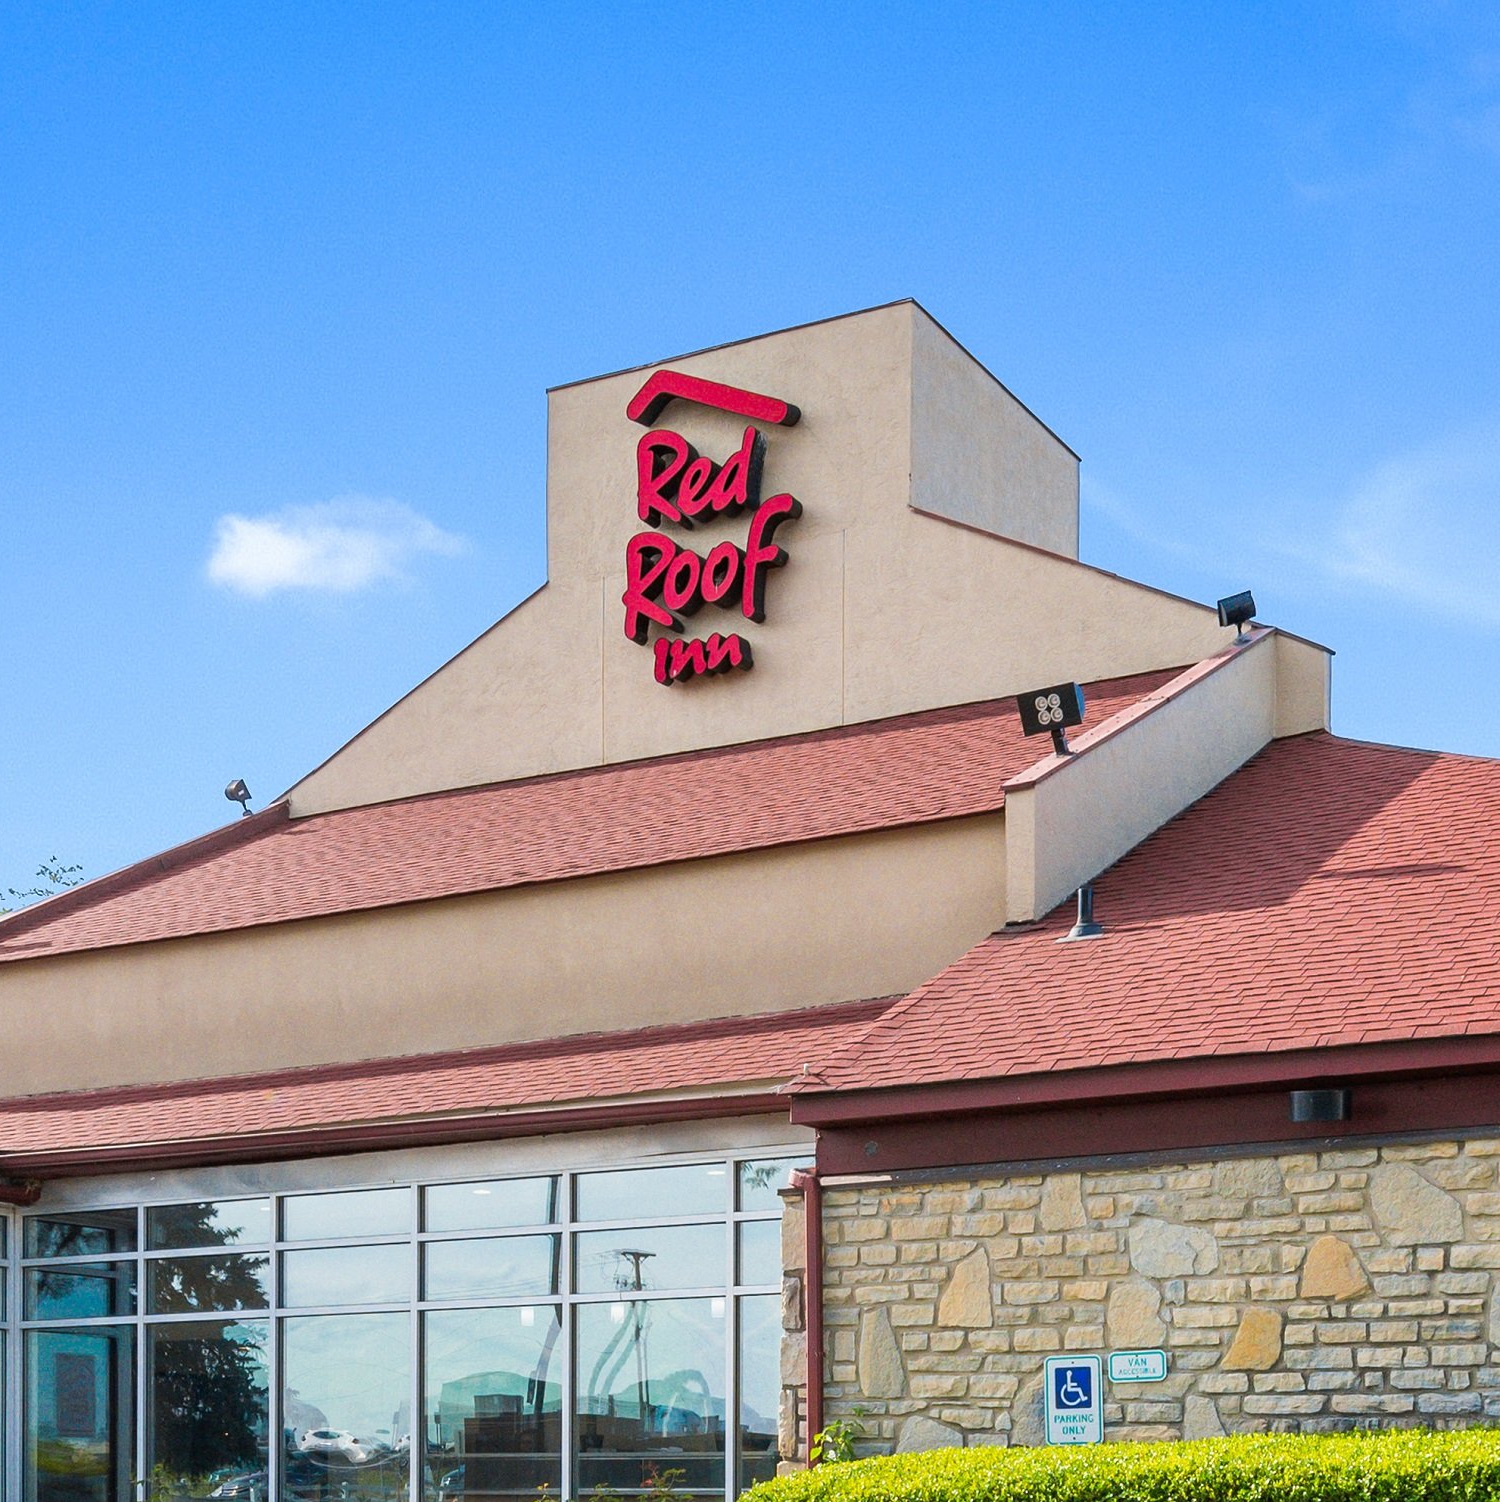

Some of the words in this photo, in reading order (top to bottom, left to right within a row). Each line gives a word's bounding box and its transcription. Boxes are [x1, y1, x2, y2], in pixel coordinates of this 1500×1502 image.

[636, 425, 768, 530] Red
[622, 493, 803, 646] Roof
[1128, 1358, 1147, 1367] VAN
[1054, 1414, 1094, 1423] PARKING
[1062, 1426, 1086, 1435] ONLY
